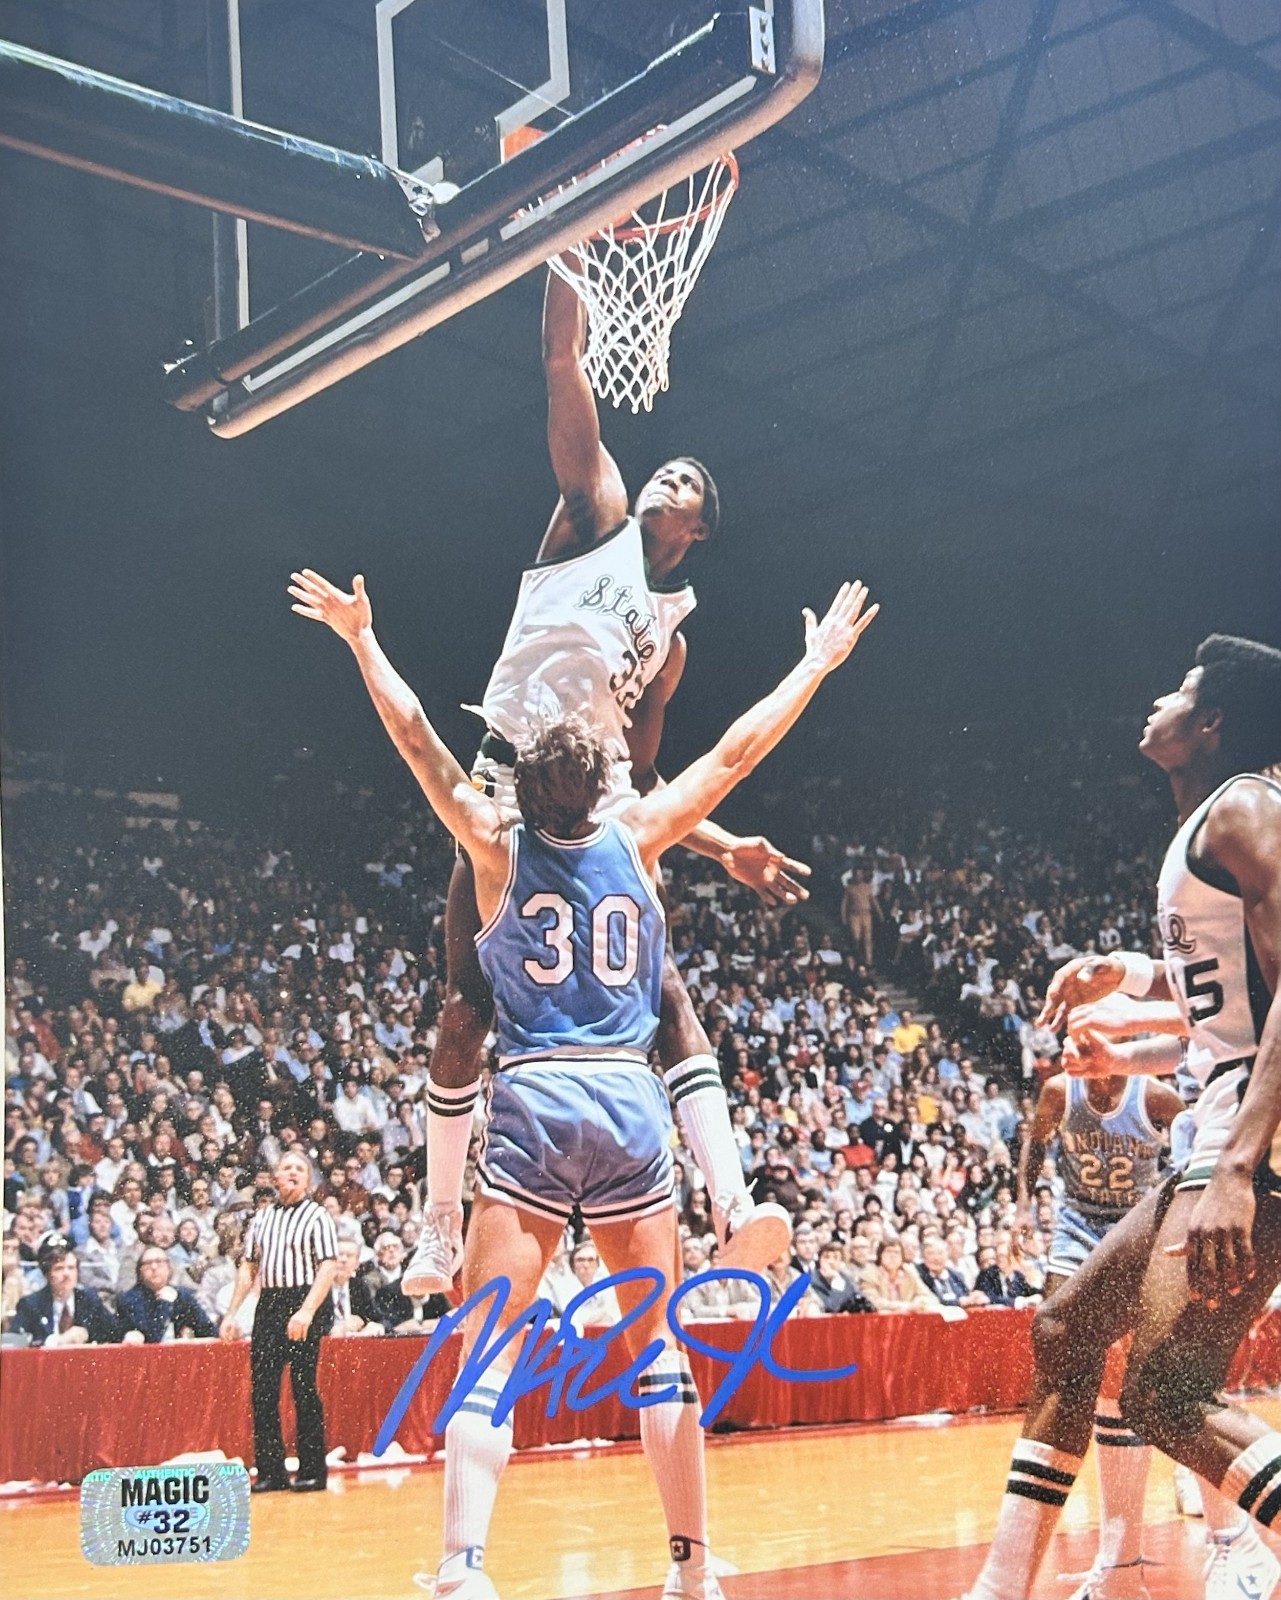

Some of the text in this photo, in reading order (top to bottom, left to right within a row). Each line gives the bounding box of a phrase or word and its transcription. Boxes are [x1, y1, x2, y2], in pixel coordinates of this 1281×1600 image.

[574, 575, 658, 669] State
[518, 891, 641, 987] 30
[1079, 1153, 1134, 1191] 22
[134, 1468, 196, 1480] AUTHENTIC
[121, 1475, 209, 1507] MAGIC
[137, 1509, 190, 1534] #32
[117, 1536, 211, 1557] MJ03751
